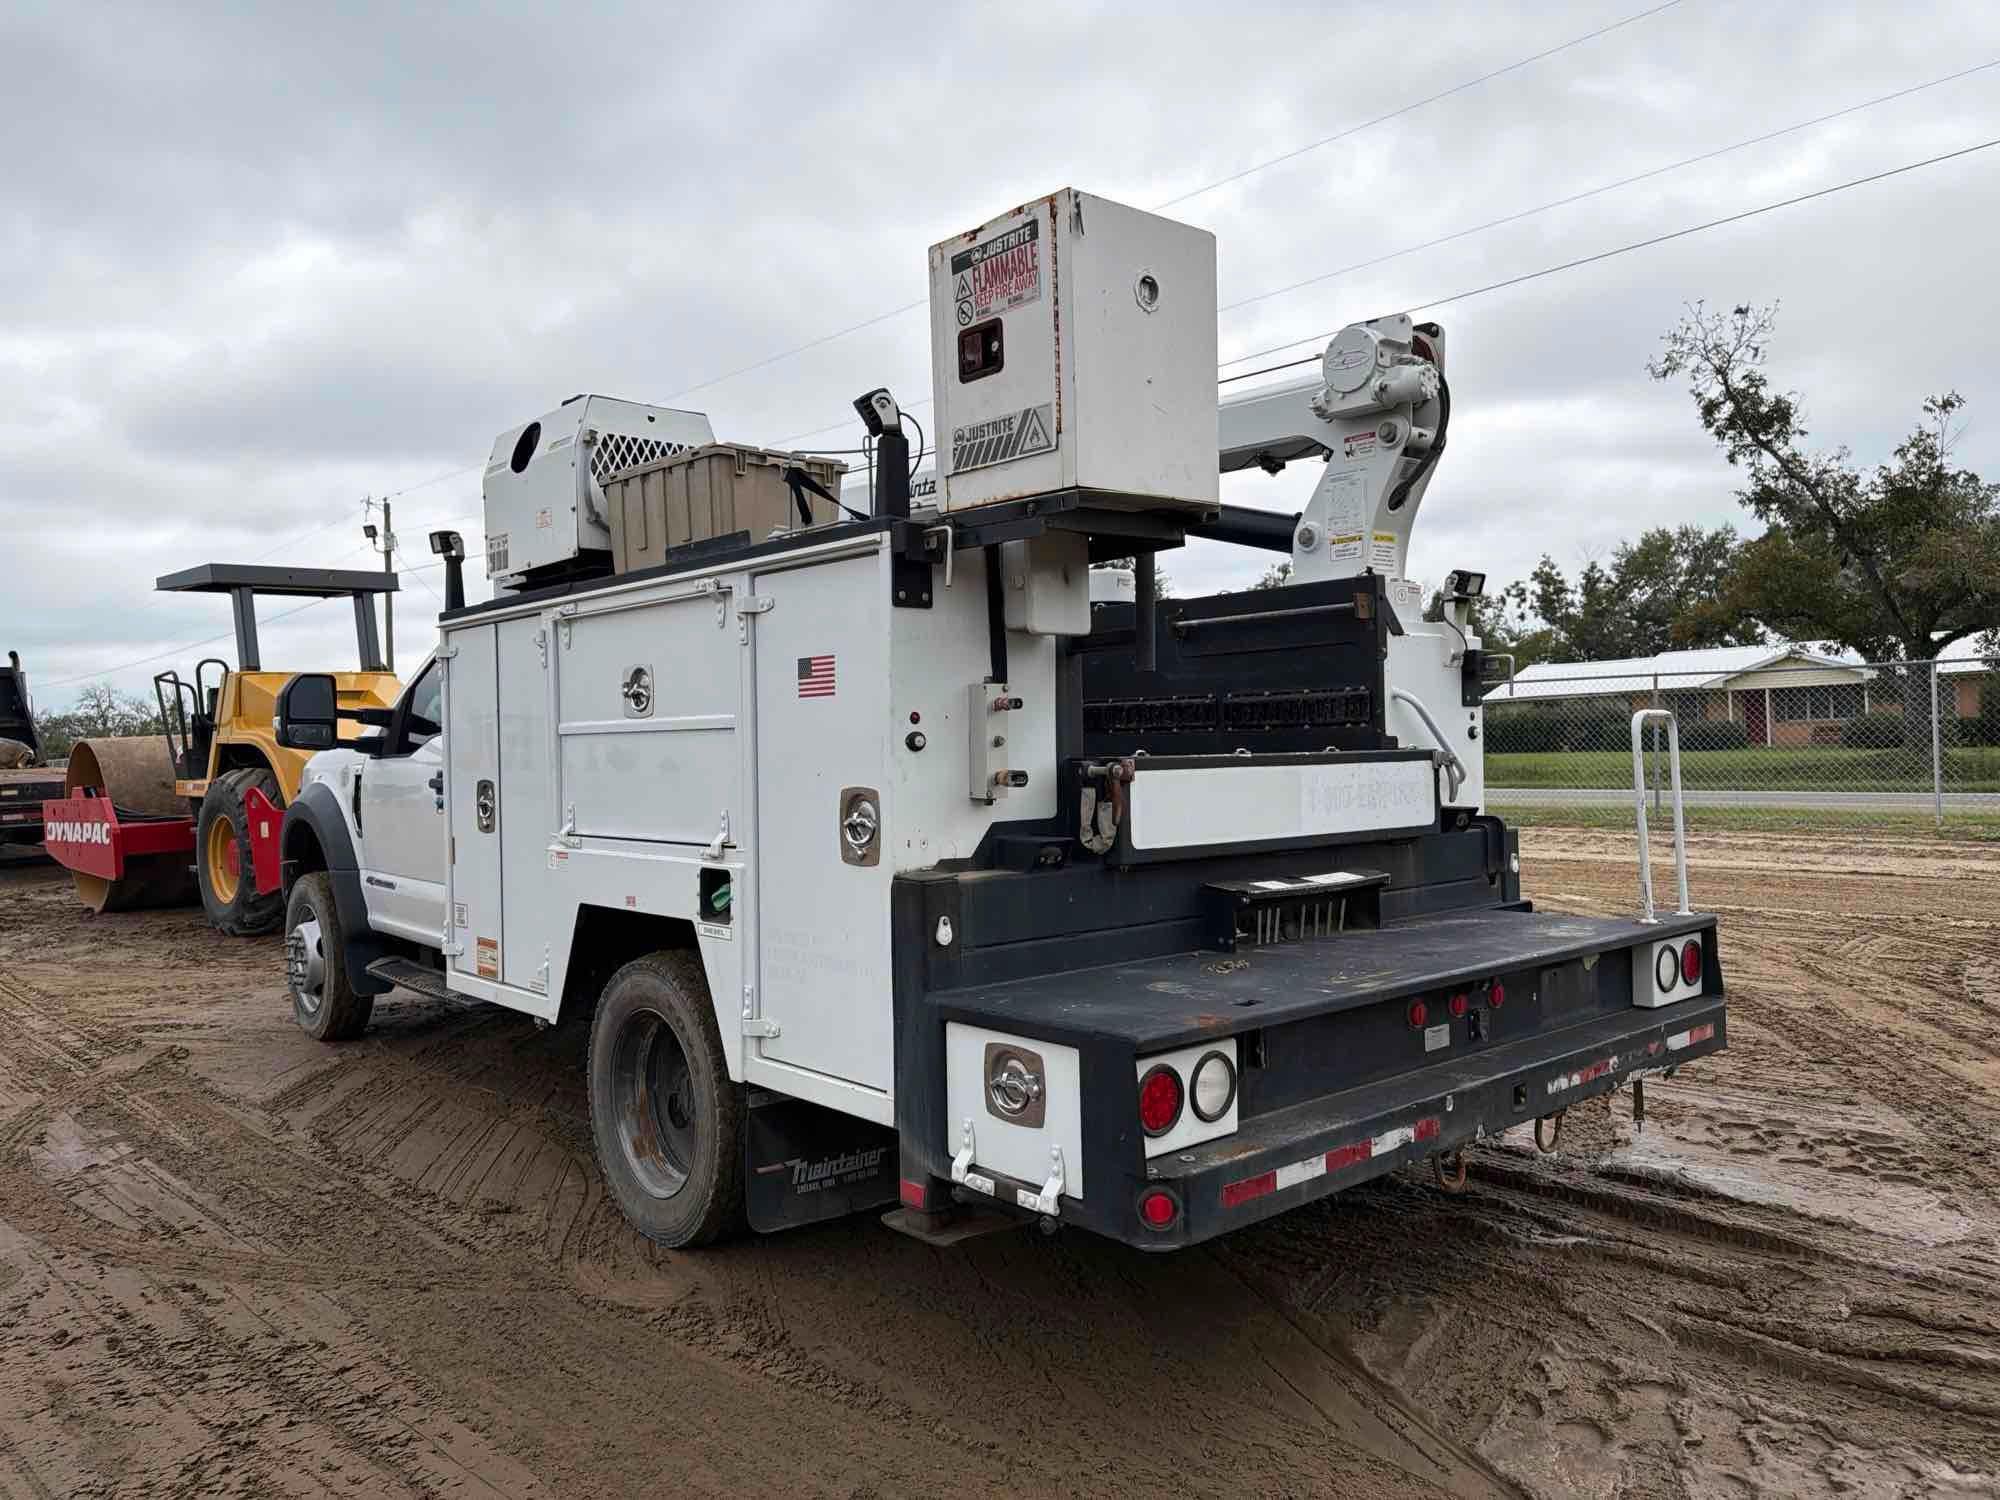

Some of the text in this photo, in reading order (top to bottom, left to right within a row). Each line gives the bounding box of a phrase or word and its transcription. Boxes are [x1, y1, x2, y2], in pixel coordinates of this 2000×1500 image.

[983, 225, 1031, 258] JUSTRITE
[972, 241, 1038, 289] FLAMMABLE
[975, 290, 993, 309] KEEP
[994, 280, 1013, 300] FIRE
[1014, 271, 1037, 293] AWAY
[966, 416, 1014, 443] JUSTRITE
[47, 821, 111, 845] DYNAPAC
